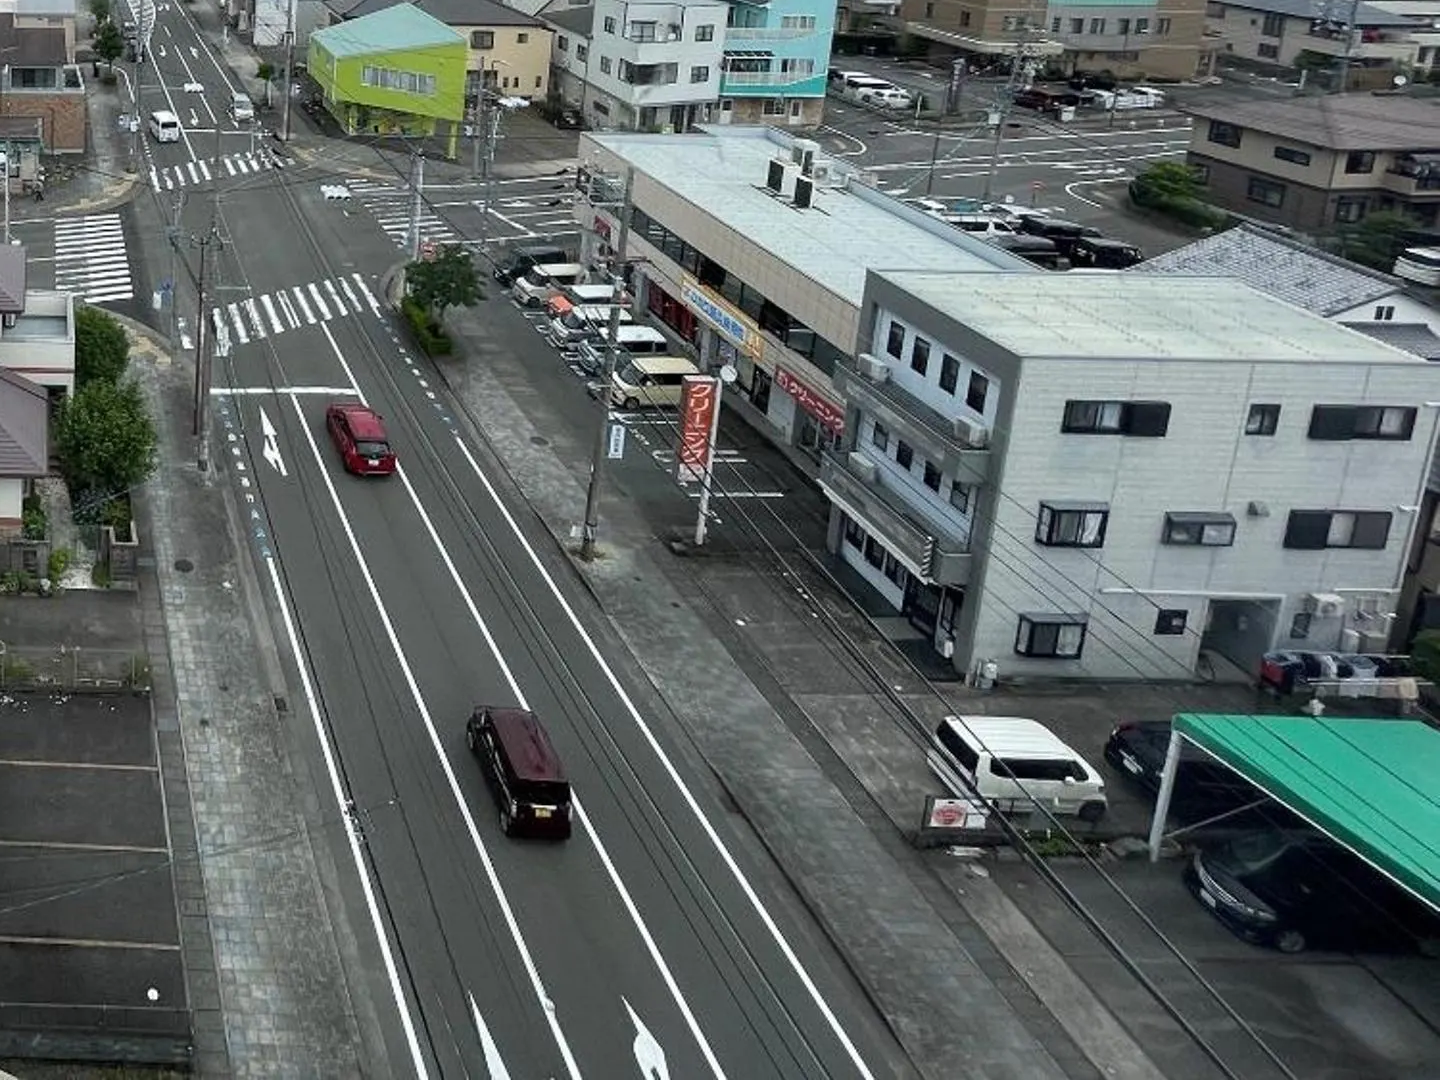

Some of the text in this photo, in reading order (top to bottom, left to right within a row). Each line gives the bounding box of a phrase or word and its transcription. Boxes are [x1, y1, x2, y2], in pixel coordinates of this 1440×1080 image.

[682, 384, 712, 463] クリーニング
